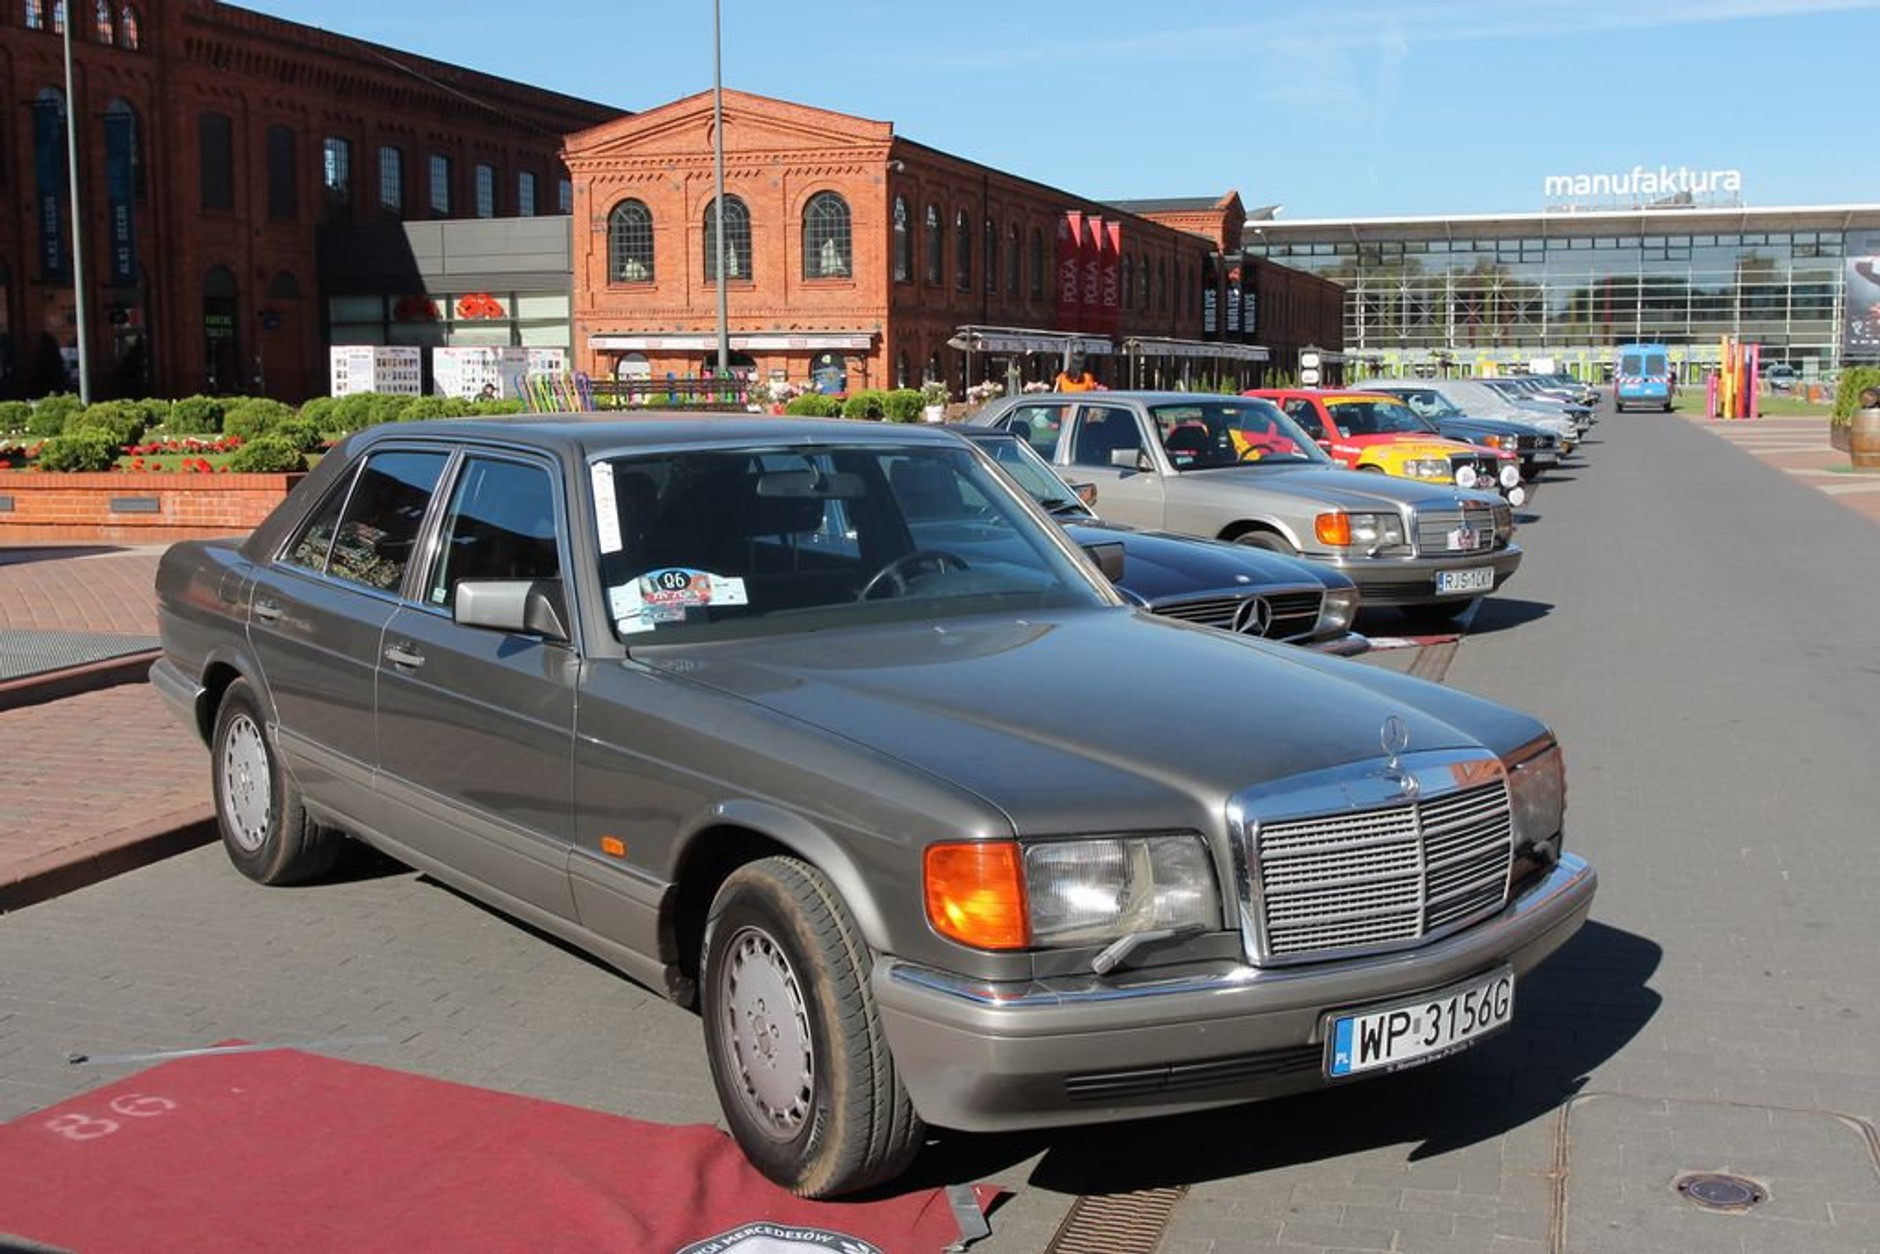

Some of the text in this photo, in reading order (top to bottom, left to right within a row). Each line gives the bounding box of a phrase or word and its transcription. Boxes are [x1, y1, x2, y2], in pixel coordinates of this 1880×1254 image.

[1545, 165, 1741, 196] manufaktura
[1062, 258, 1077, 302] POLKA
[1084, 262, 1098, 304] POLKA
[1103, 265, 1117, 306] POLKA
[1204, 288, 1217, 332] SATURN
[1227, 287, 1240, 331] SATURN
[1244, 293, 1256, 333] SATURN
[1360, 977, 1510, 1063] WP 3156G
[1336, 1052, 1349, 1065] PL
[721, 1226, 833, 1246] MERCEDESÓW
